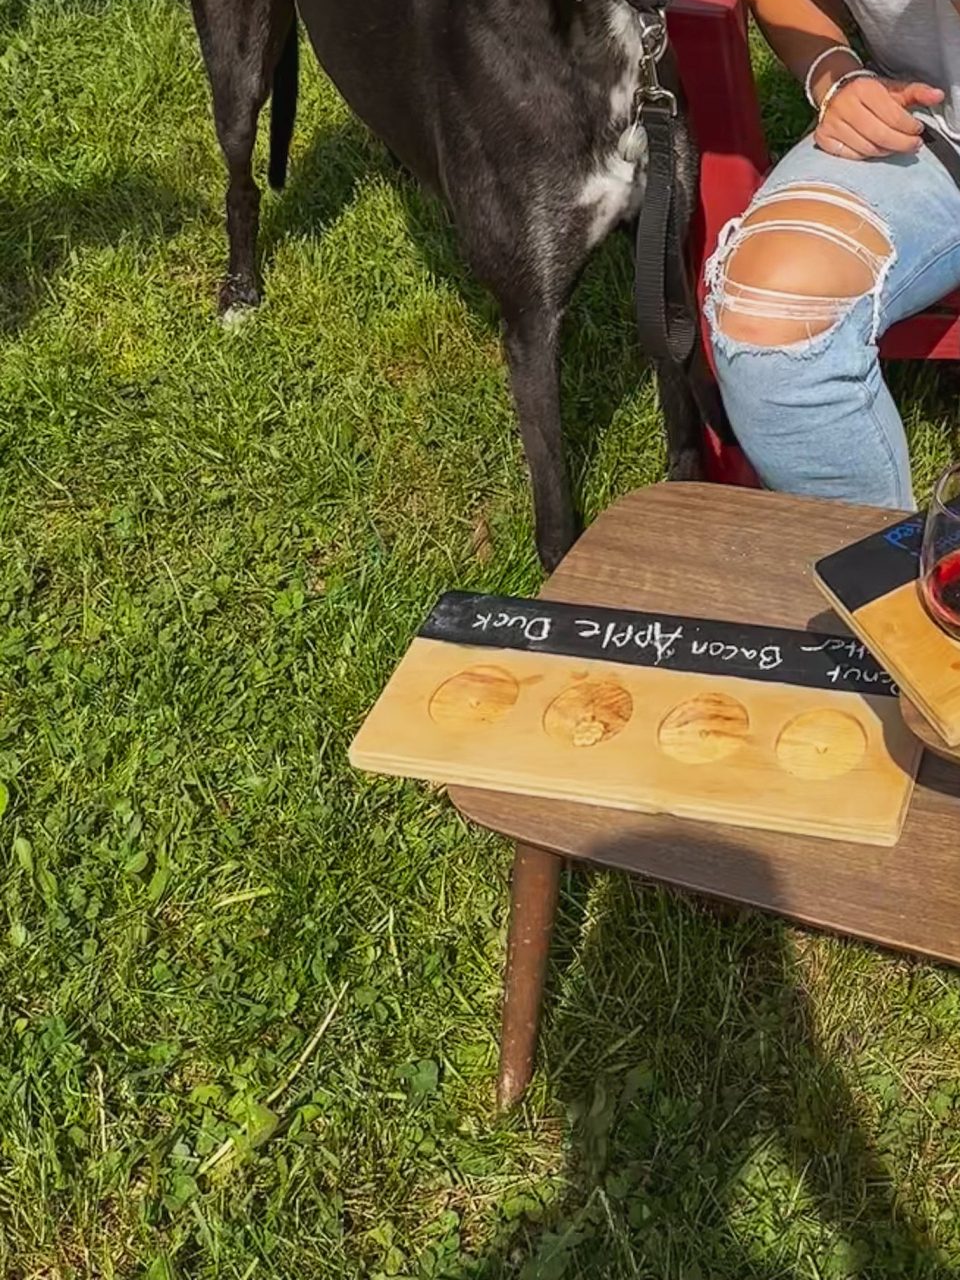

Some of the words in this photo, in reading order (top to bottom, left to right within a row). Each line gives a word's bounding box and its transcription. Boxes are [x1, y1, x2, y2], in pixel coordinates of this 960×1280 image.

[472, 612, 551, 641] Duck
[576, 619, 682, 664] Apple
[692, 640, 783, 670] Bacon
